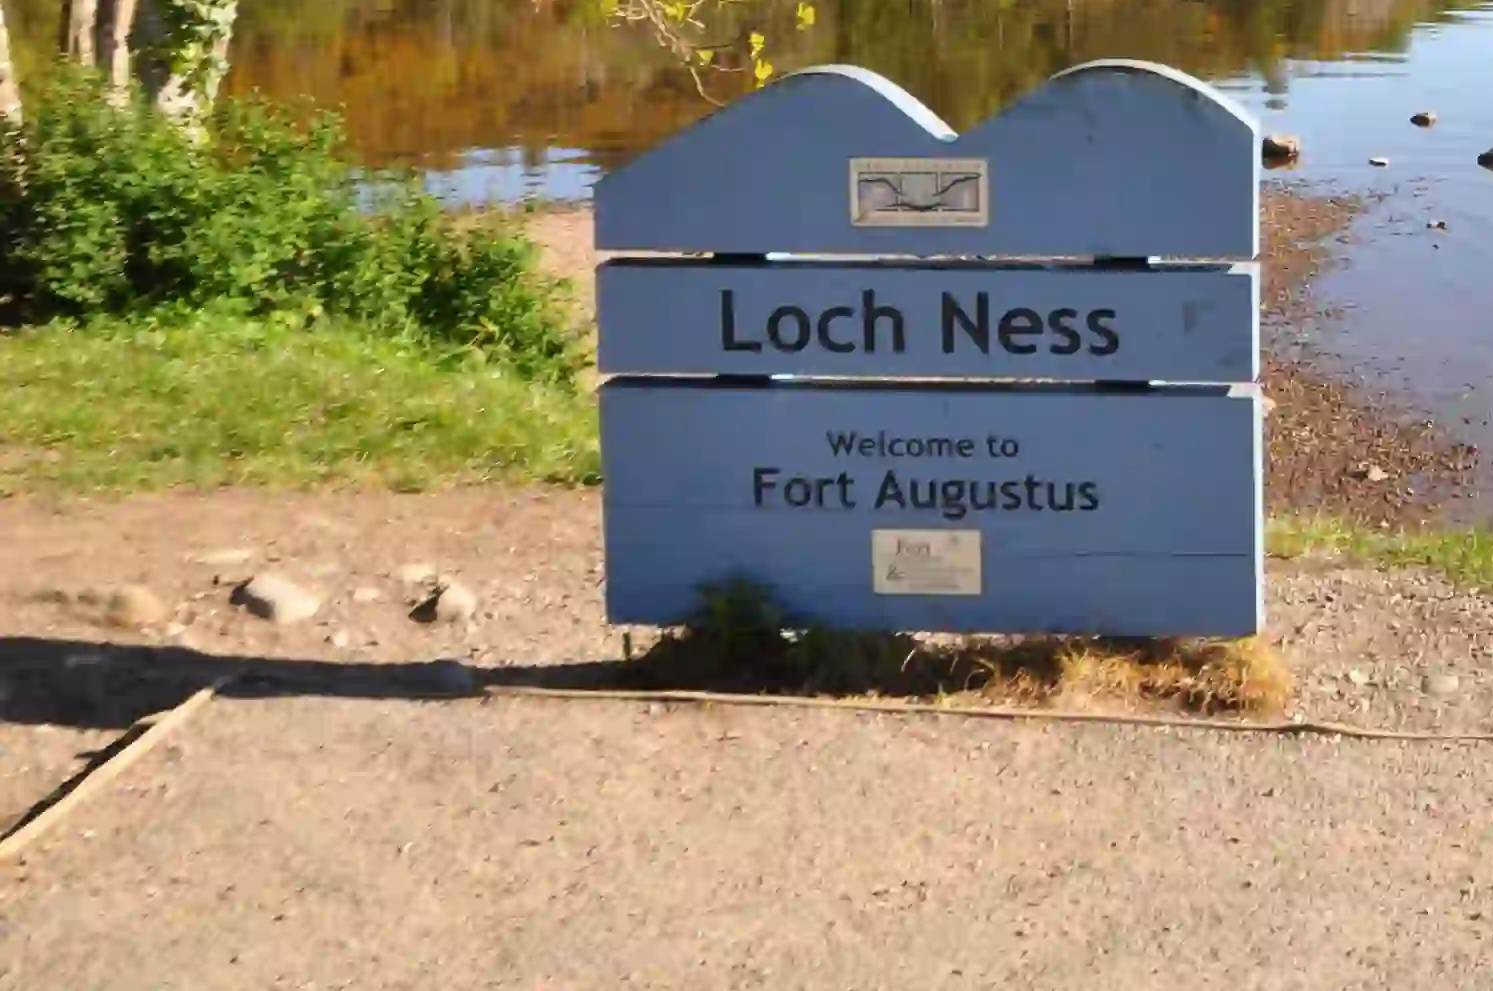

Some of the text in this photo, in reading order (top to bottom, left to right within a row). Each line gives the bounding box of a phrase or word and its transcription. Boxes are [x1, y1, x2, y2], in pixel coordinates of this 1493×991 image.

[719, 289, 1121, 356] Loch Ness
[826, 430, 1020, 459] Welcome to
[753, 468, 1100, 520] Fort Augustus
